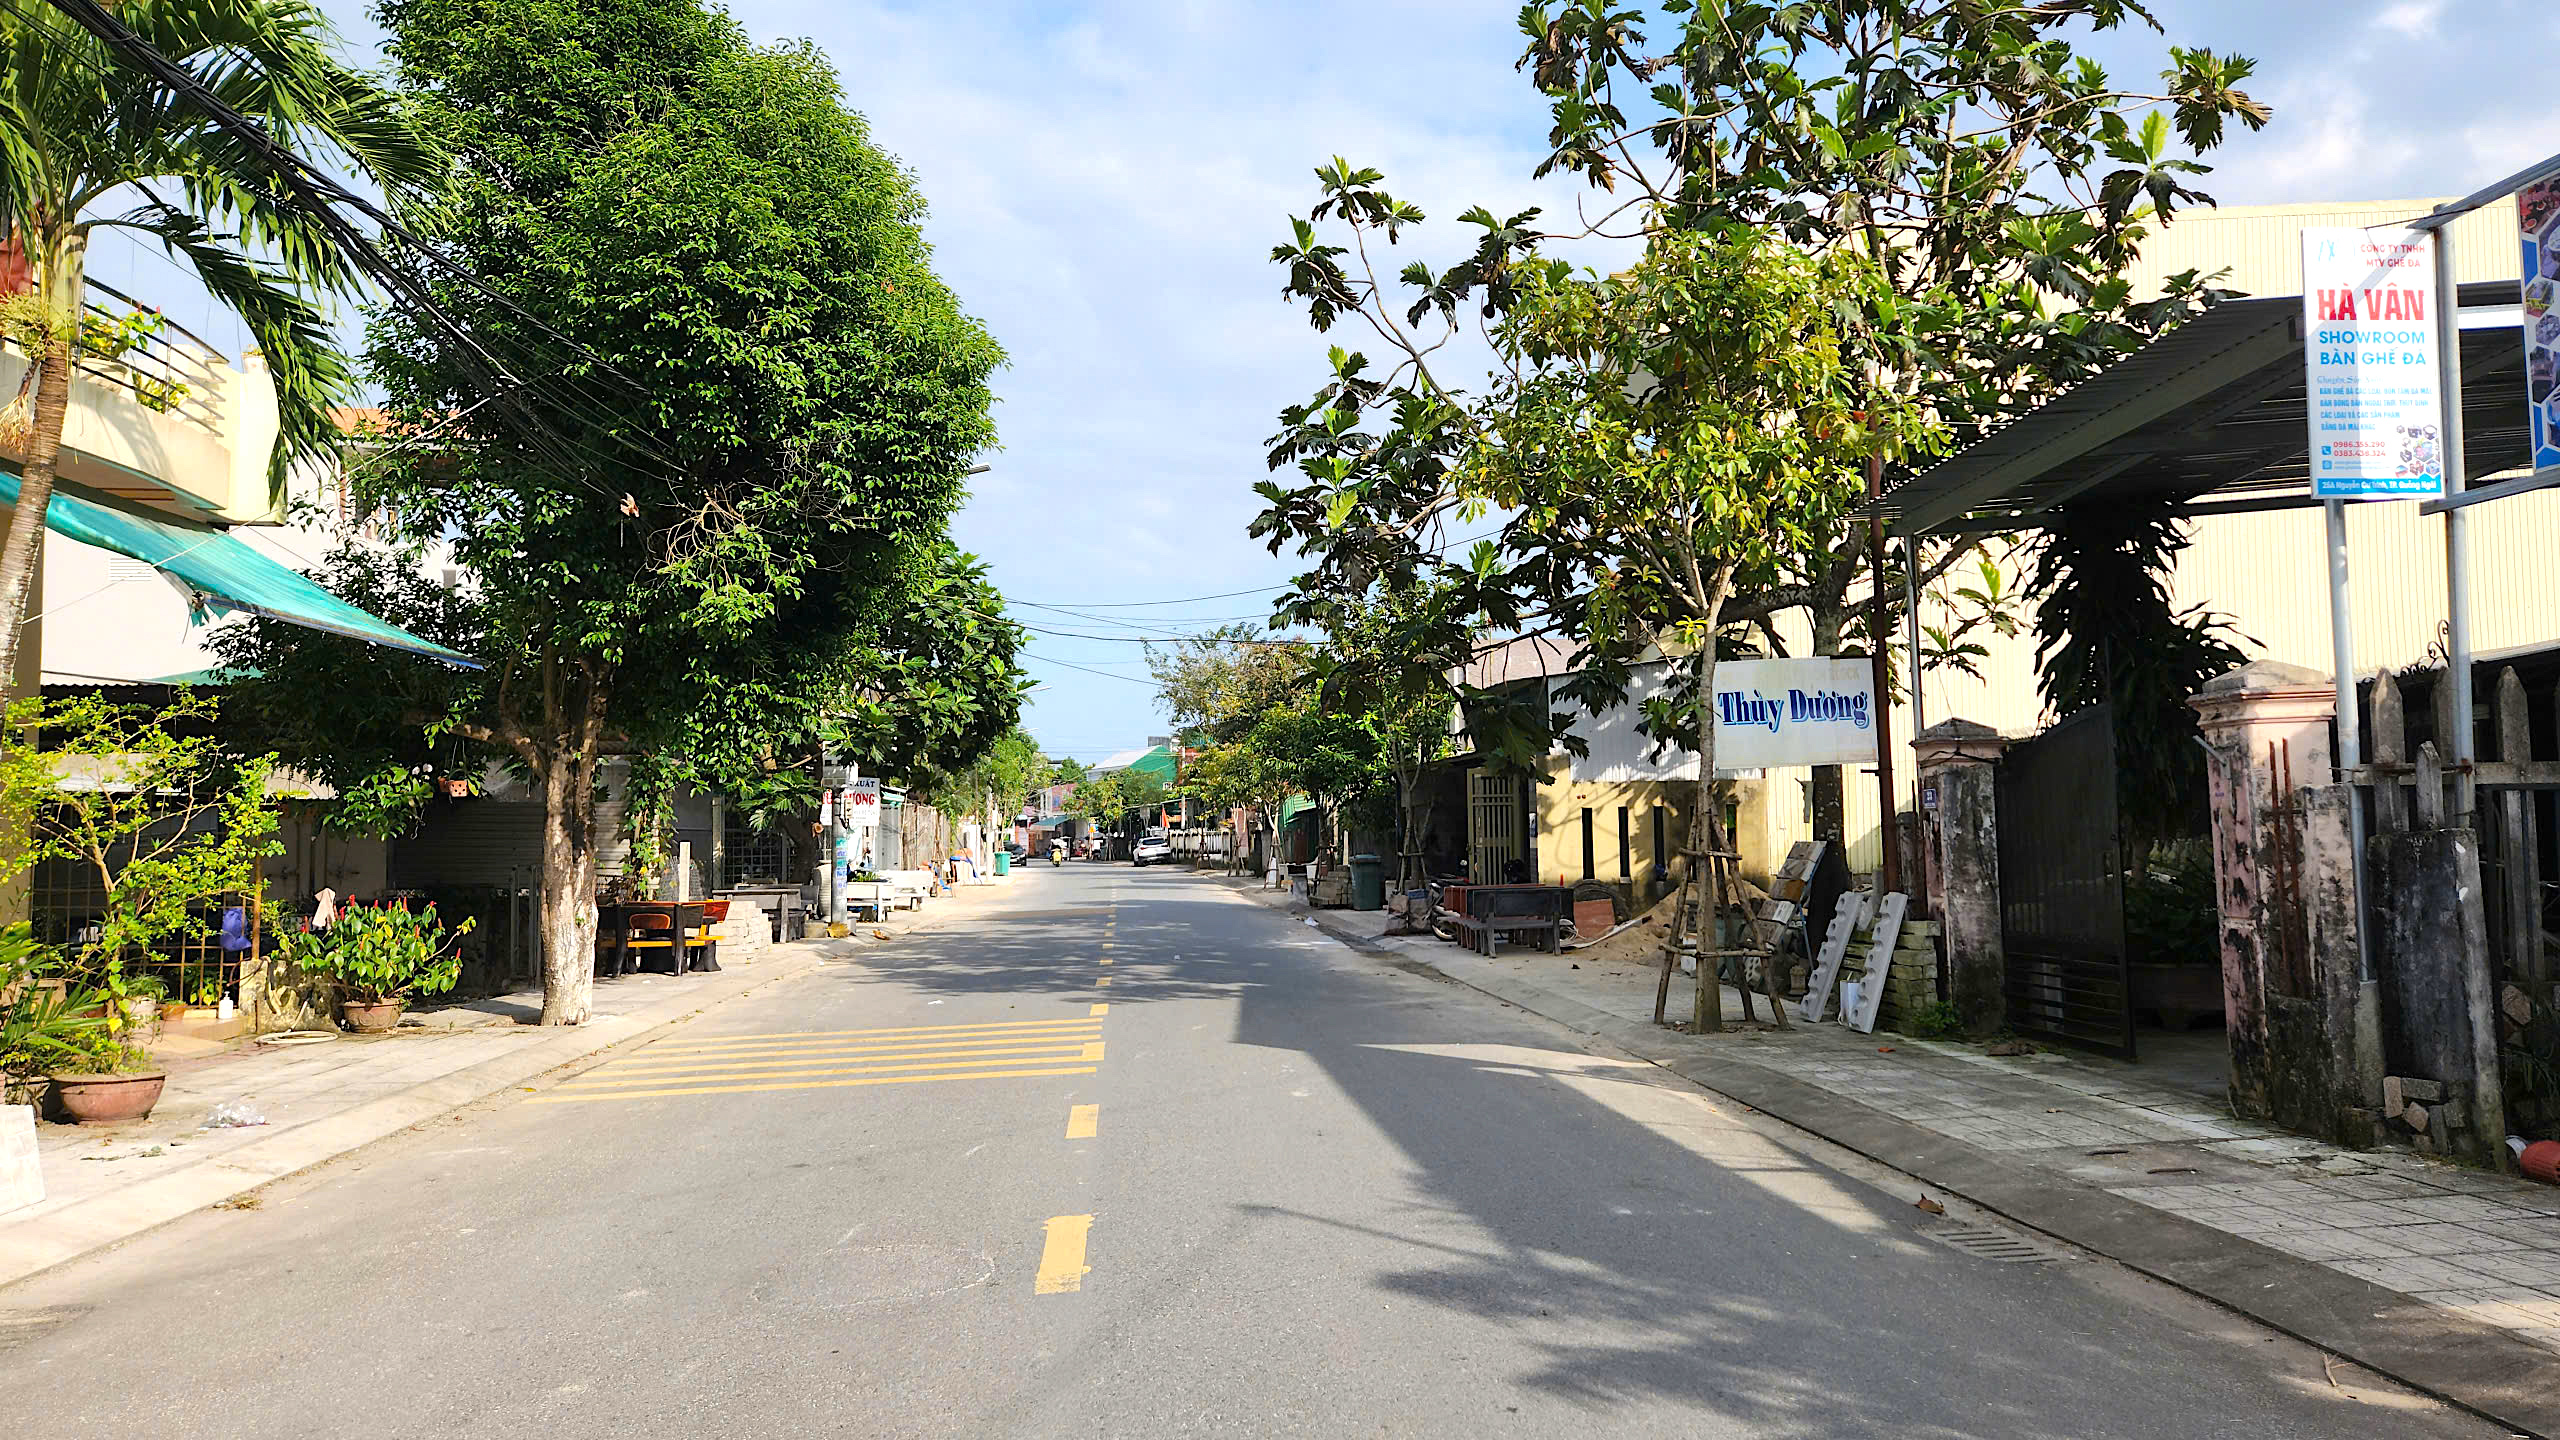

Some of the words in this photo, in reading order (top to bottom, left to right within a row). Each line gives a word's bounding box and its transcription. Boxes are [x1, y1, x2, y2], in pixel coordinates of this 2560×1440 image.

[2400, 244, 2425, 253] TNHH
[2317, 282, 2357, 320] HÀ
[2364, 282, 2424, 320] VÂN
[2320, 330, 2425, 344] SHOWROOM
[2320, 348, 2355, 364] BÀN
[2362, 346, 2398, 364] GHẾ
[2402, 348, 2426, 364] ĐÁ
[1718, 690, 1784, 735] Thùy
[1788, 690, 1868, 729] Dương
